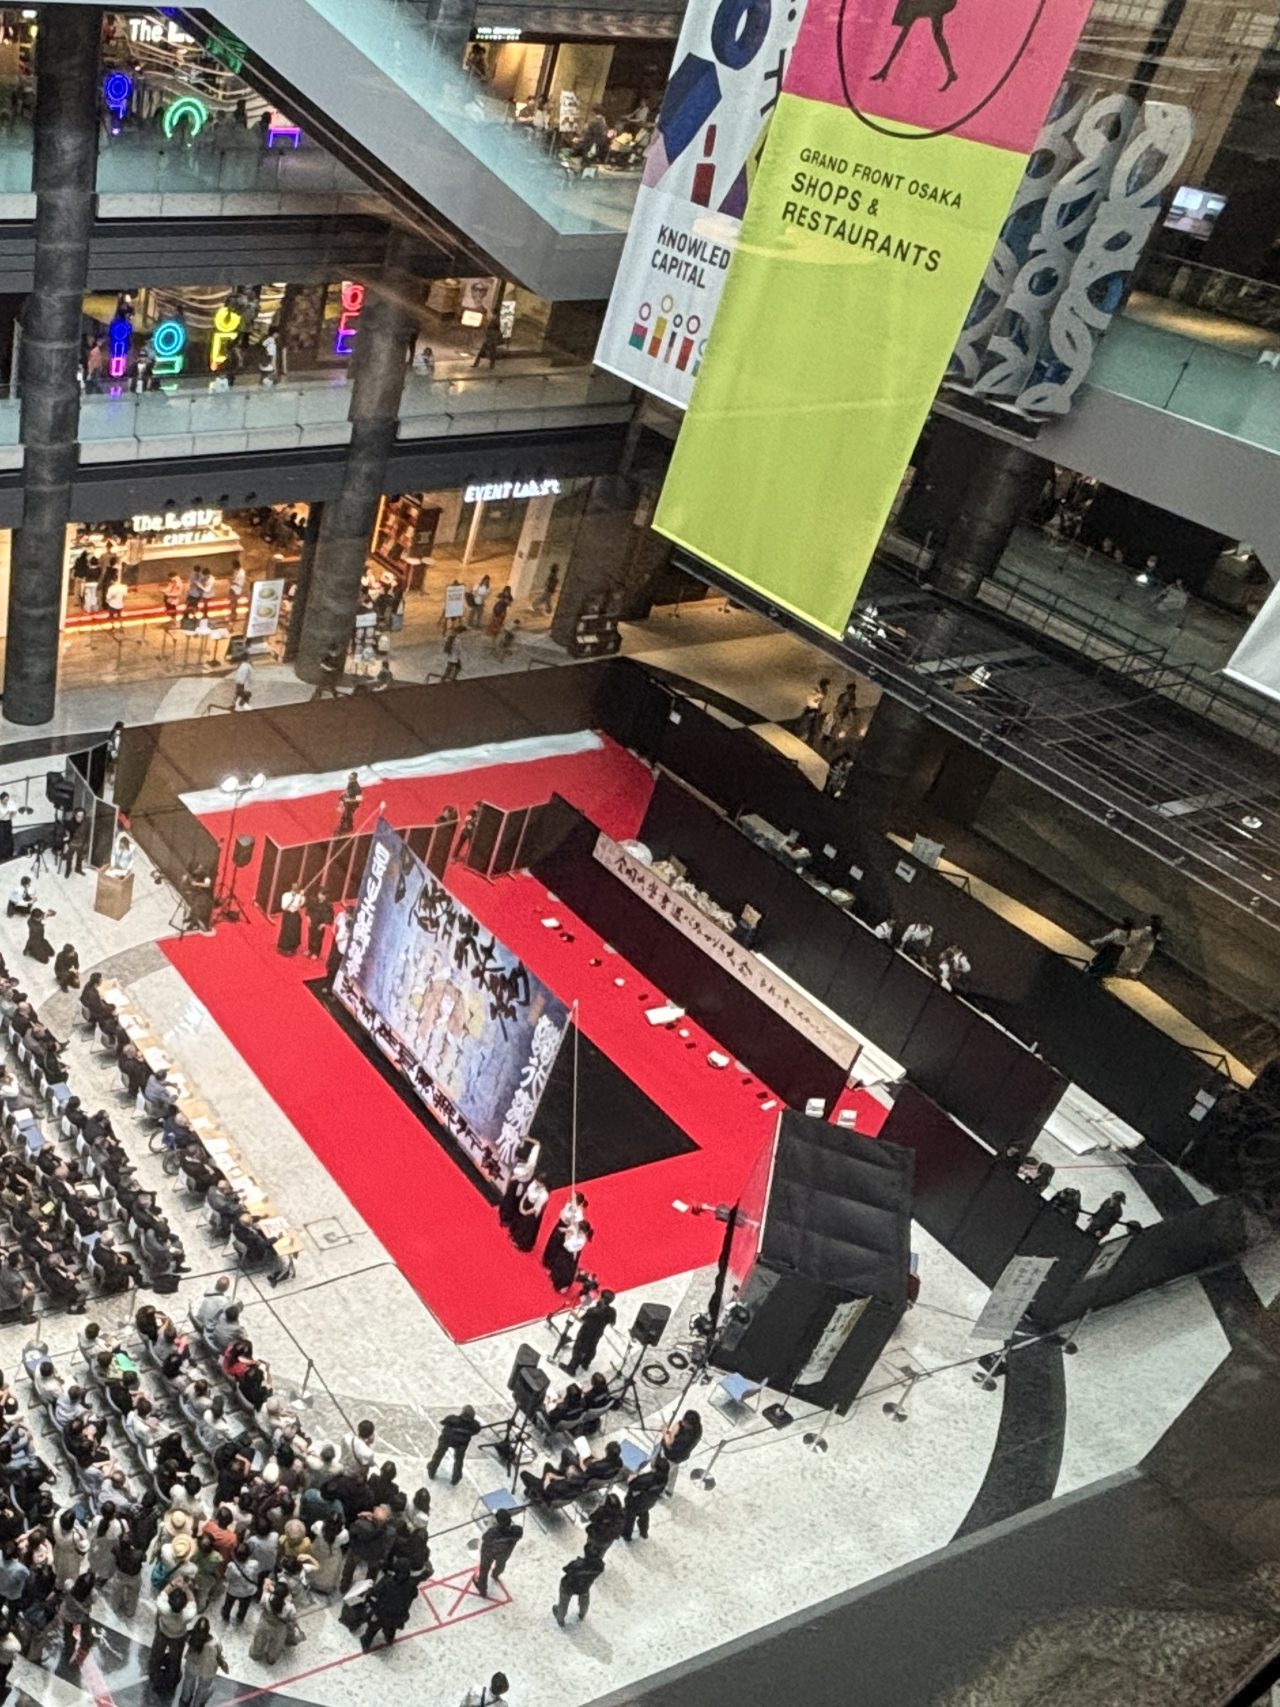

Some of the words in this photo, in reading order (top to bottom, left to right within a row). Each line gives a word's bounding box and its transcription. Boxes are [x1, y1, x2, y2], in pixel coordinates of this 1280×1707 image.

[128, 18, 163, 42] The
[791, 172, 862, 211] SHOPS
[867, 198, 879, 216] &
[799, 148, 848, 174] GRAND
[852, 163, 905, 191] FRONT
[908, 180, 962, 209] OSAKA
[657, 224, 731, 270] KNOWLED
[782, 201, 941, 272] RESTAURANTS
[651, 249, 705, 289] CAPITAL
[464, 482, 512, 503] EVENT
[131, 515, 163, 532] The
